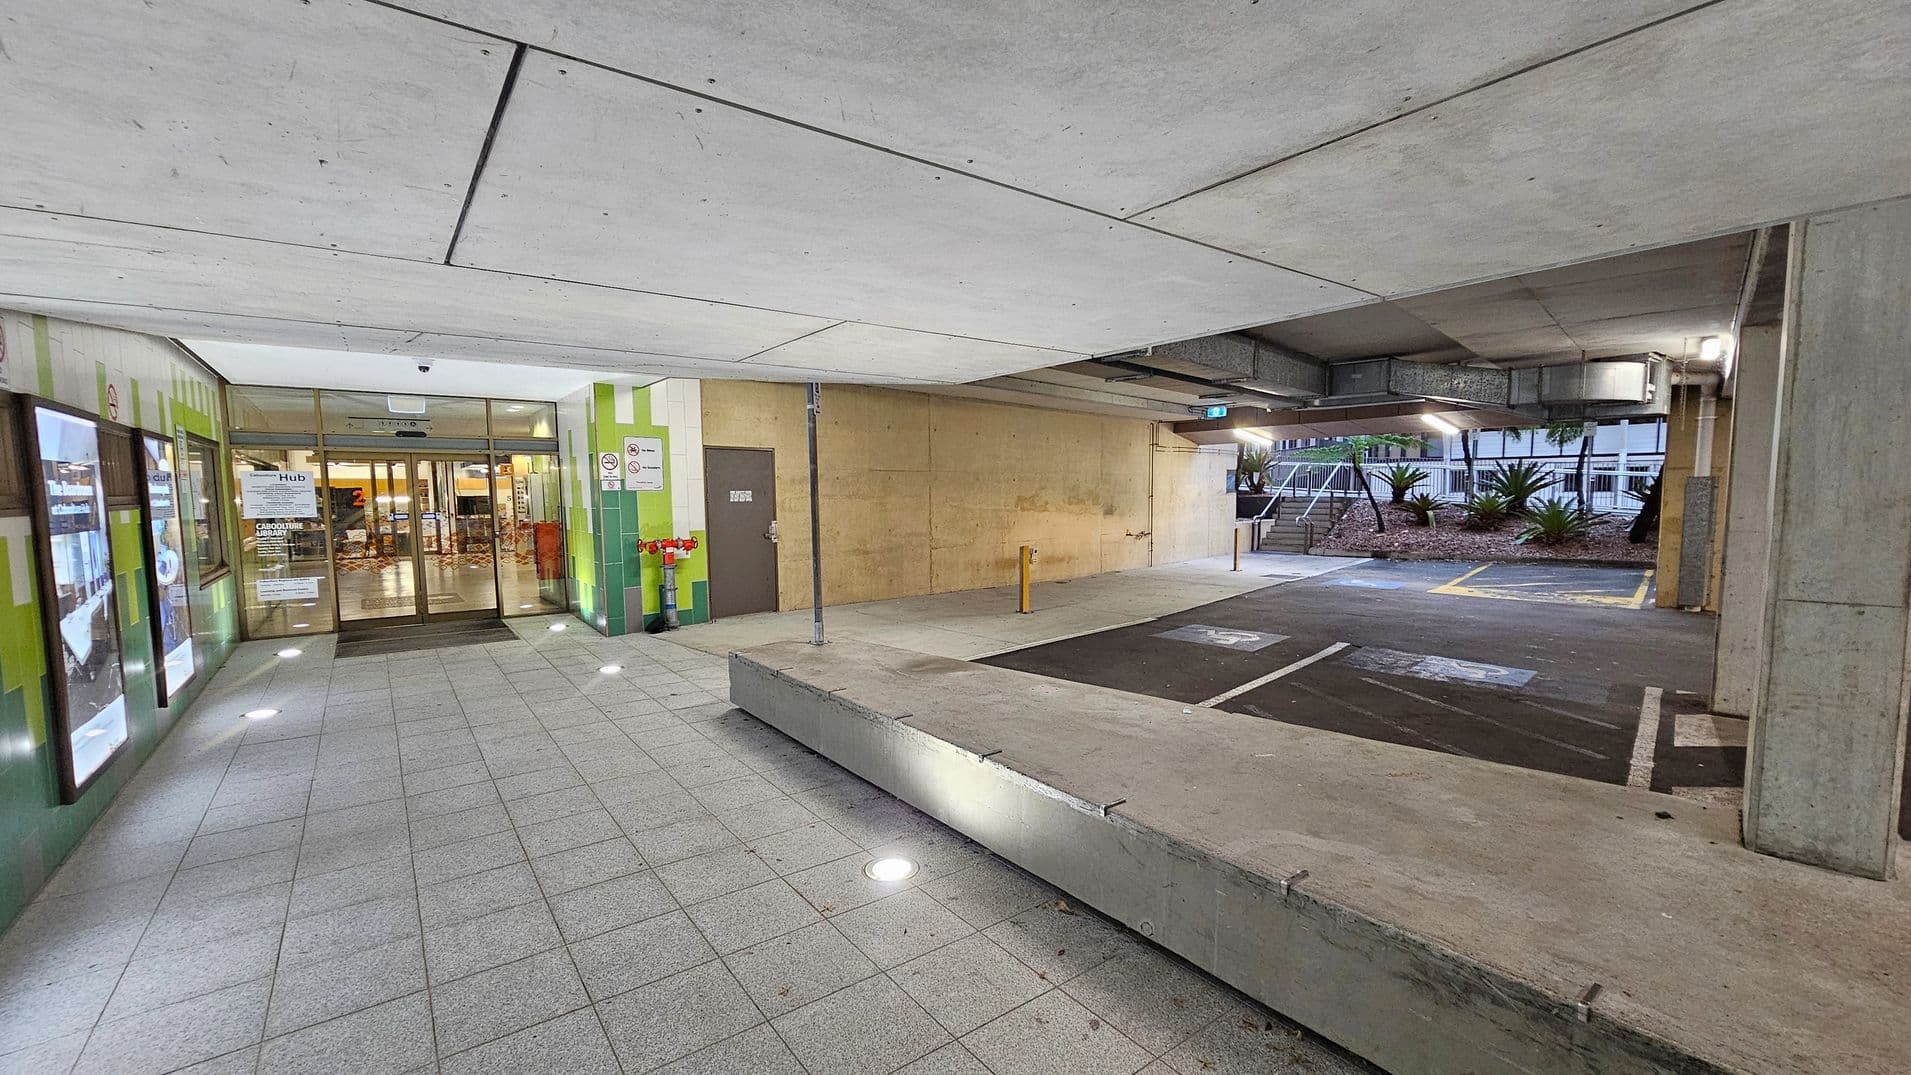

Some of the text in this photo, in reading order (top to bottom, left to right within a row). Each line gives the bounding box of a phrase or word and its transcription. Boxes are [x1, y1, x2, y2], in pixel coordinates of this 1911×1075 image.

[279, 473, 306, 482] Hub
[255, 522, 304, 530] CABOOLTURE
[255, 529, 287, 537] LIBRARY
